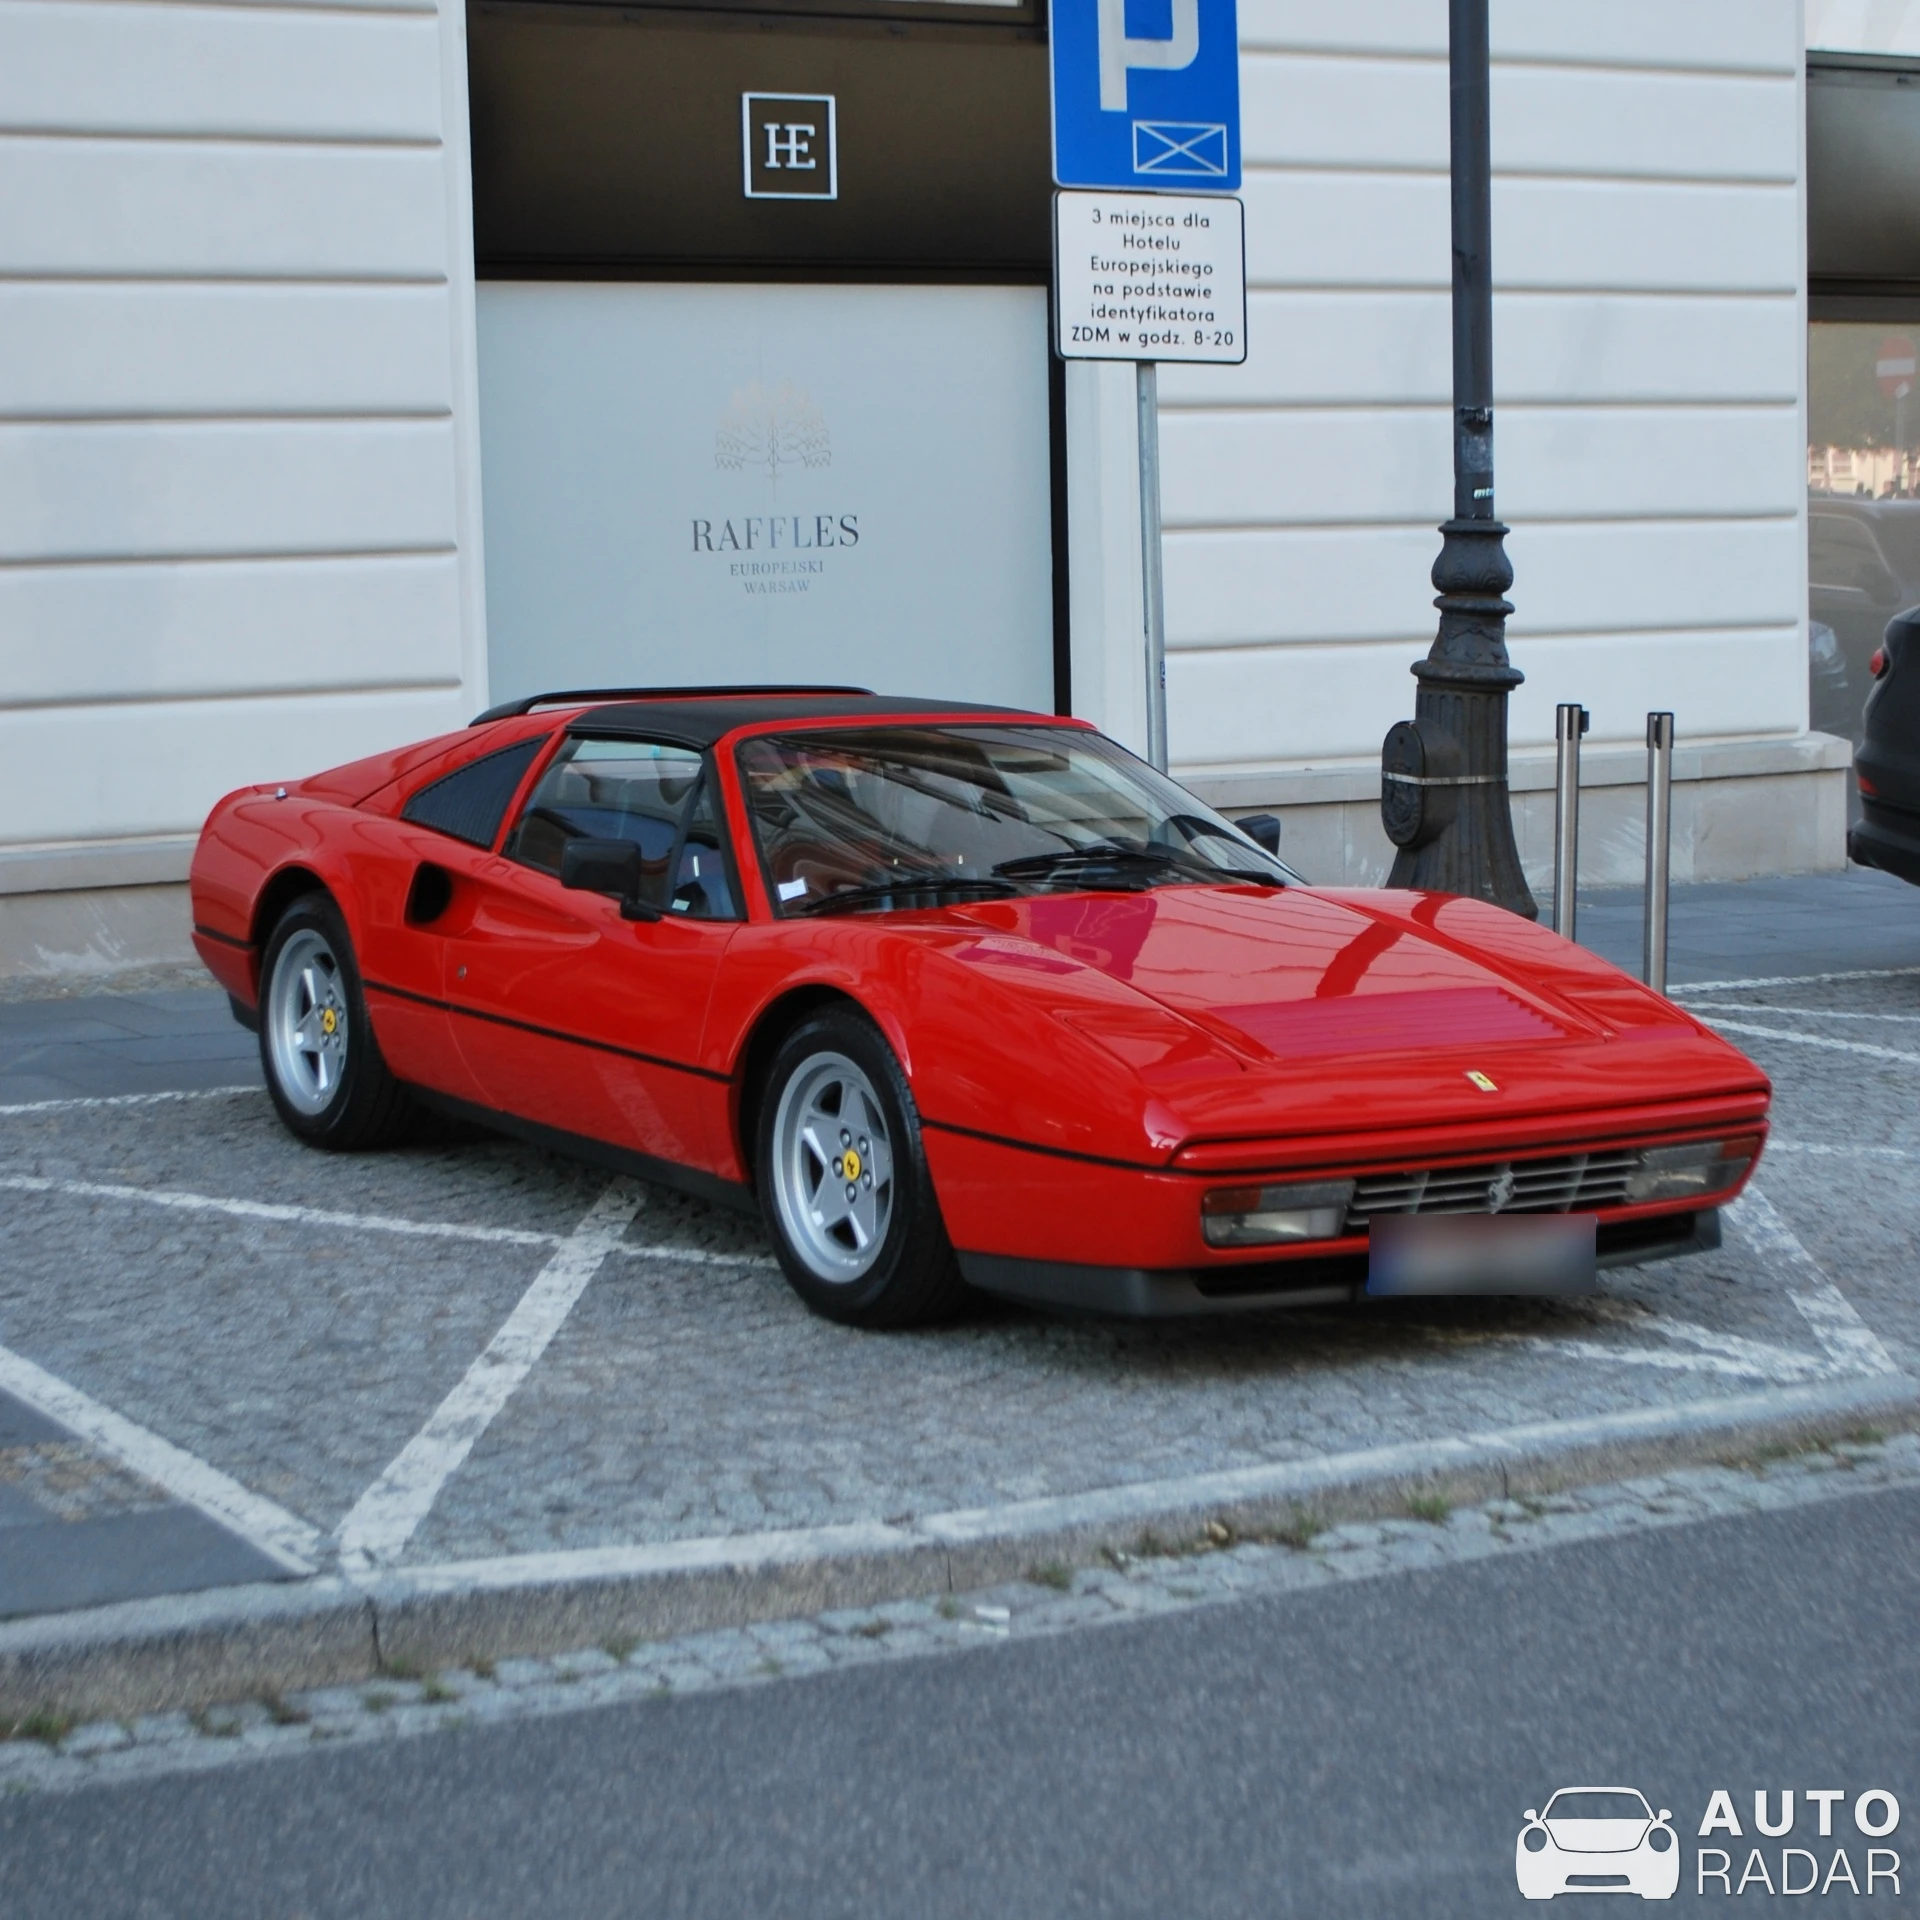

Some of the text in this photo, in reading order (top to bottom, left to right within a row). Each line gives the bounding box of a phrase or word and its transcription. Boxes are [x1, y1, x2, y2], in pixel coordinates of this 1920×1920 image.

[763, 122, 816, 169] HE
[1092, 208, 1210, 229] 3 miejsca dla
[1123, 234, 1180, 250] Hotelu
[1091, 256, 1213, 279] Europejskiego
[1093, 282, 1212, 300] na podstawie
[1091, 303, 1214, 324] identyfikatora
[1072, 326, 1234, 348] ZDM w godz. 8-20
[691, 514, 859, 552] RAFFLES
[730, 560, 824, 577] EUROPEJSKI
[744, 579, 810, 595] WARSAW
